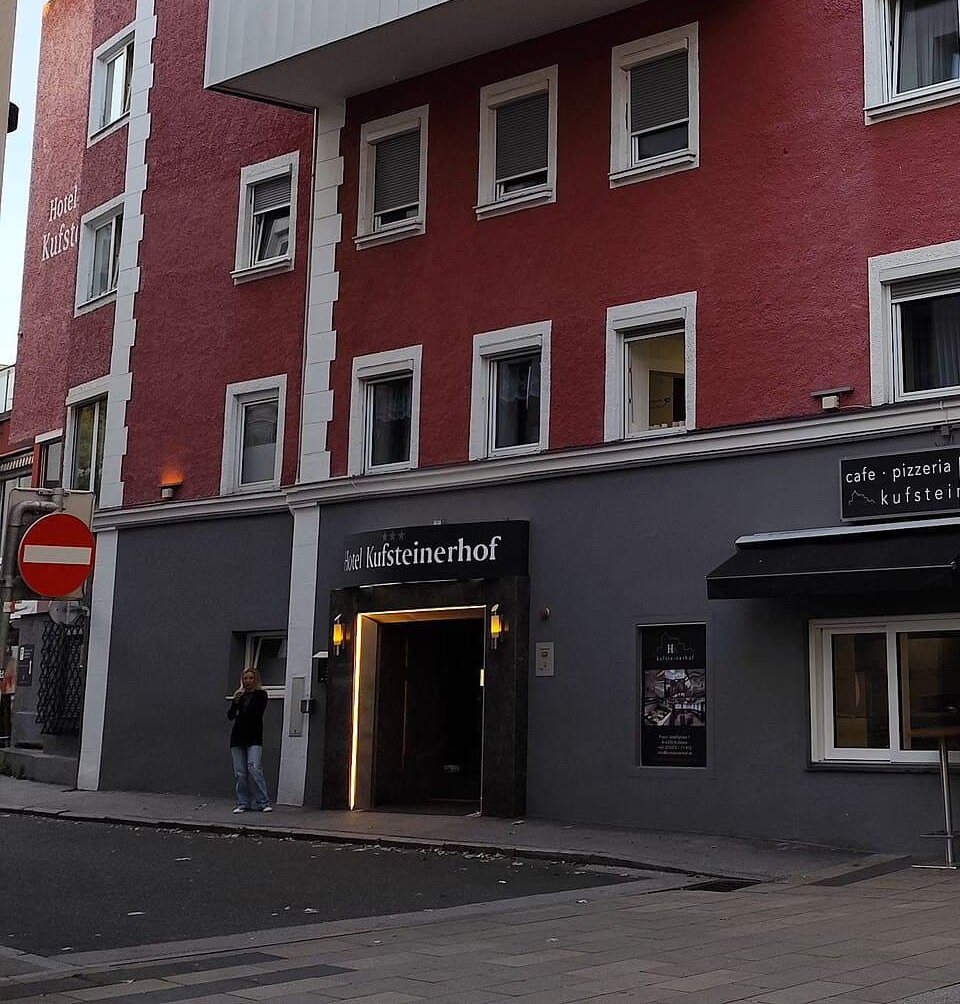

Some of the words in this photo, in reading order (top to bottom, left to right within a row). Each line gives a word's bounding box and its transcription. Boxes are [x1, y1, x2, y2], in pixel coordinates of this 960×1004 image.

[49, 184, 78, 222] Hotel
[845, 466, 876, 484] cafe
[892, 459, 951, 483] pizzeria
[343, 547, 363, 572] Hotel
[366, 536, 502, 569] Kufsteinerhof
